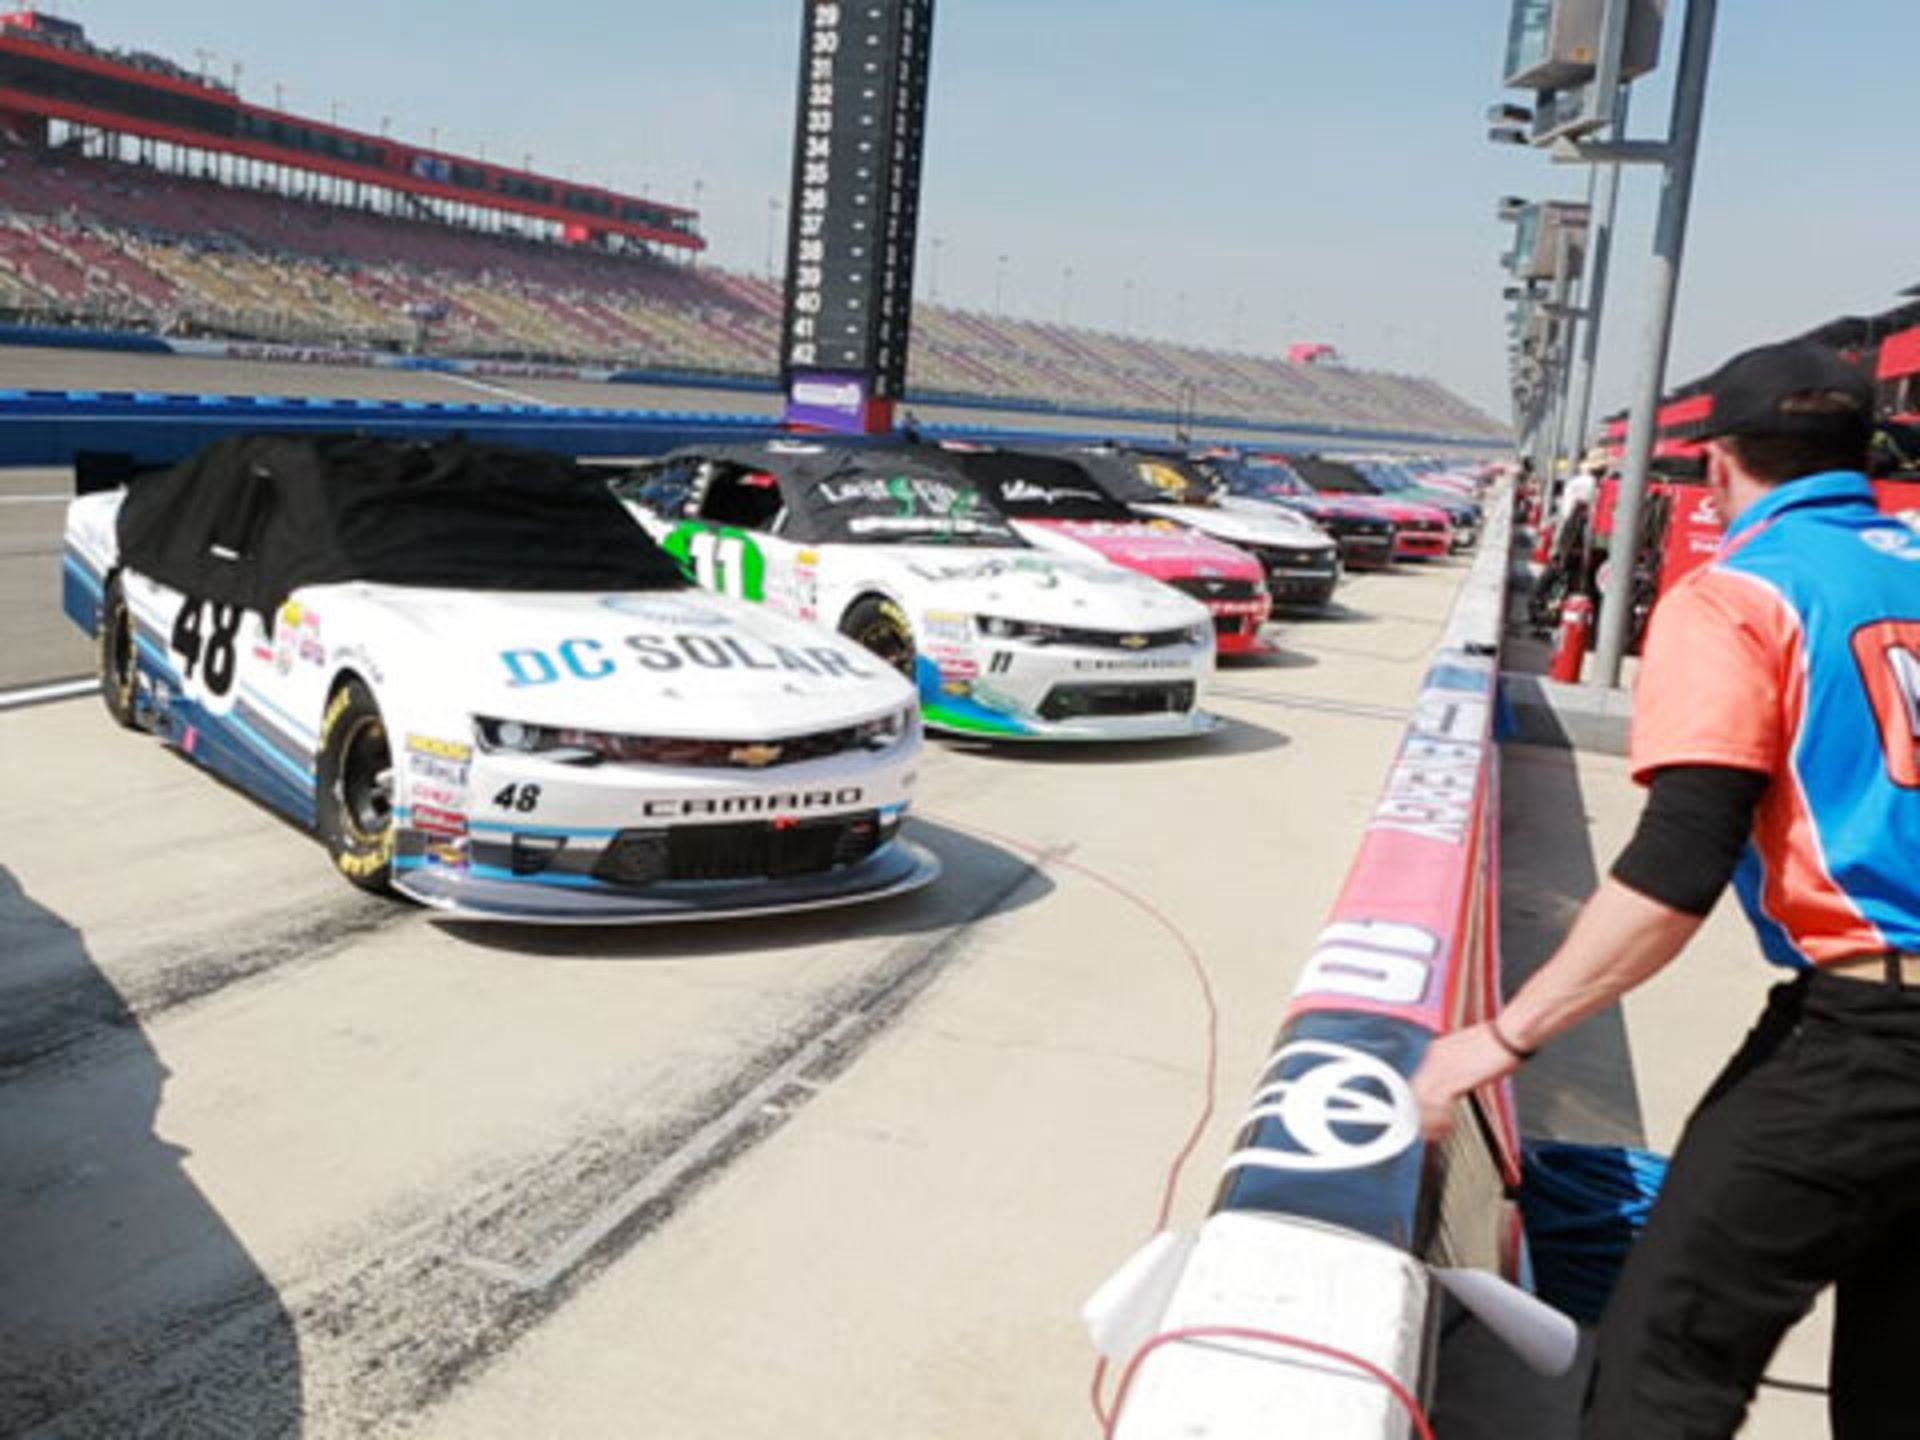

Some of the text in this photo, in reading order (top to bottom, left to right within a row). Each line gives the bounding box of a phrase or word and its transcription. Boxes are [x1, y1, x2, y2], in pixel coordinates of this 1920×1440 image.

[813, 31, 839, 53] 30
[795, 291, 821, 313] 40
[793, 318, 814, 337] 41
[690, 532, 743, 598] 11
[171, 598, 242, 696] 48
[499, 636, 617, 688] DC
[624, 634, 878, 680] SOLAR
[988, 651, 1014, 674] 11
[493, 782, 542, 813] 48
[642, 786, 864, 817] CAMARO
